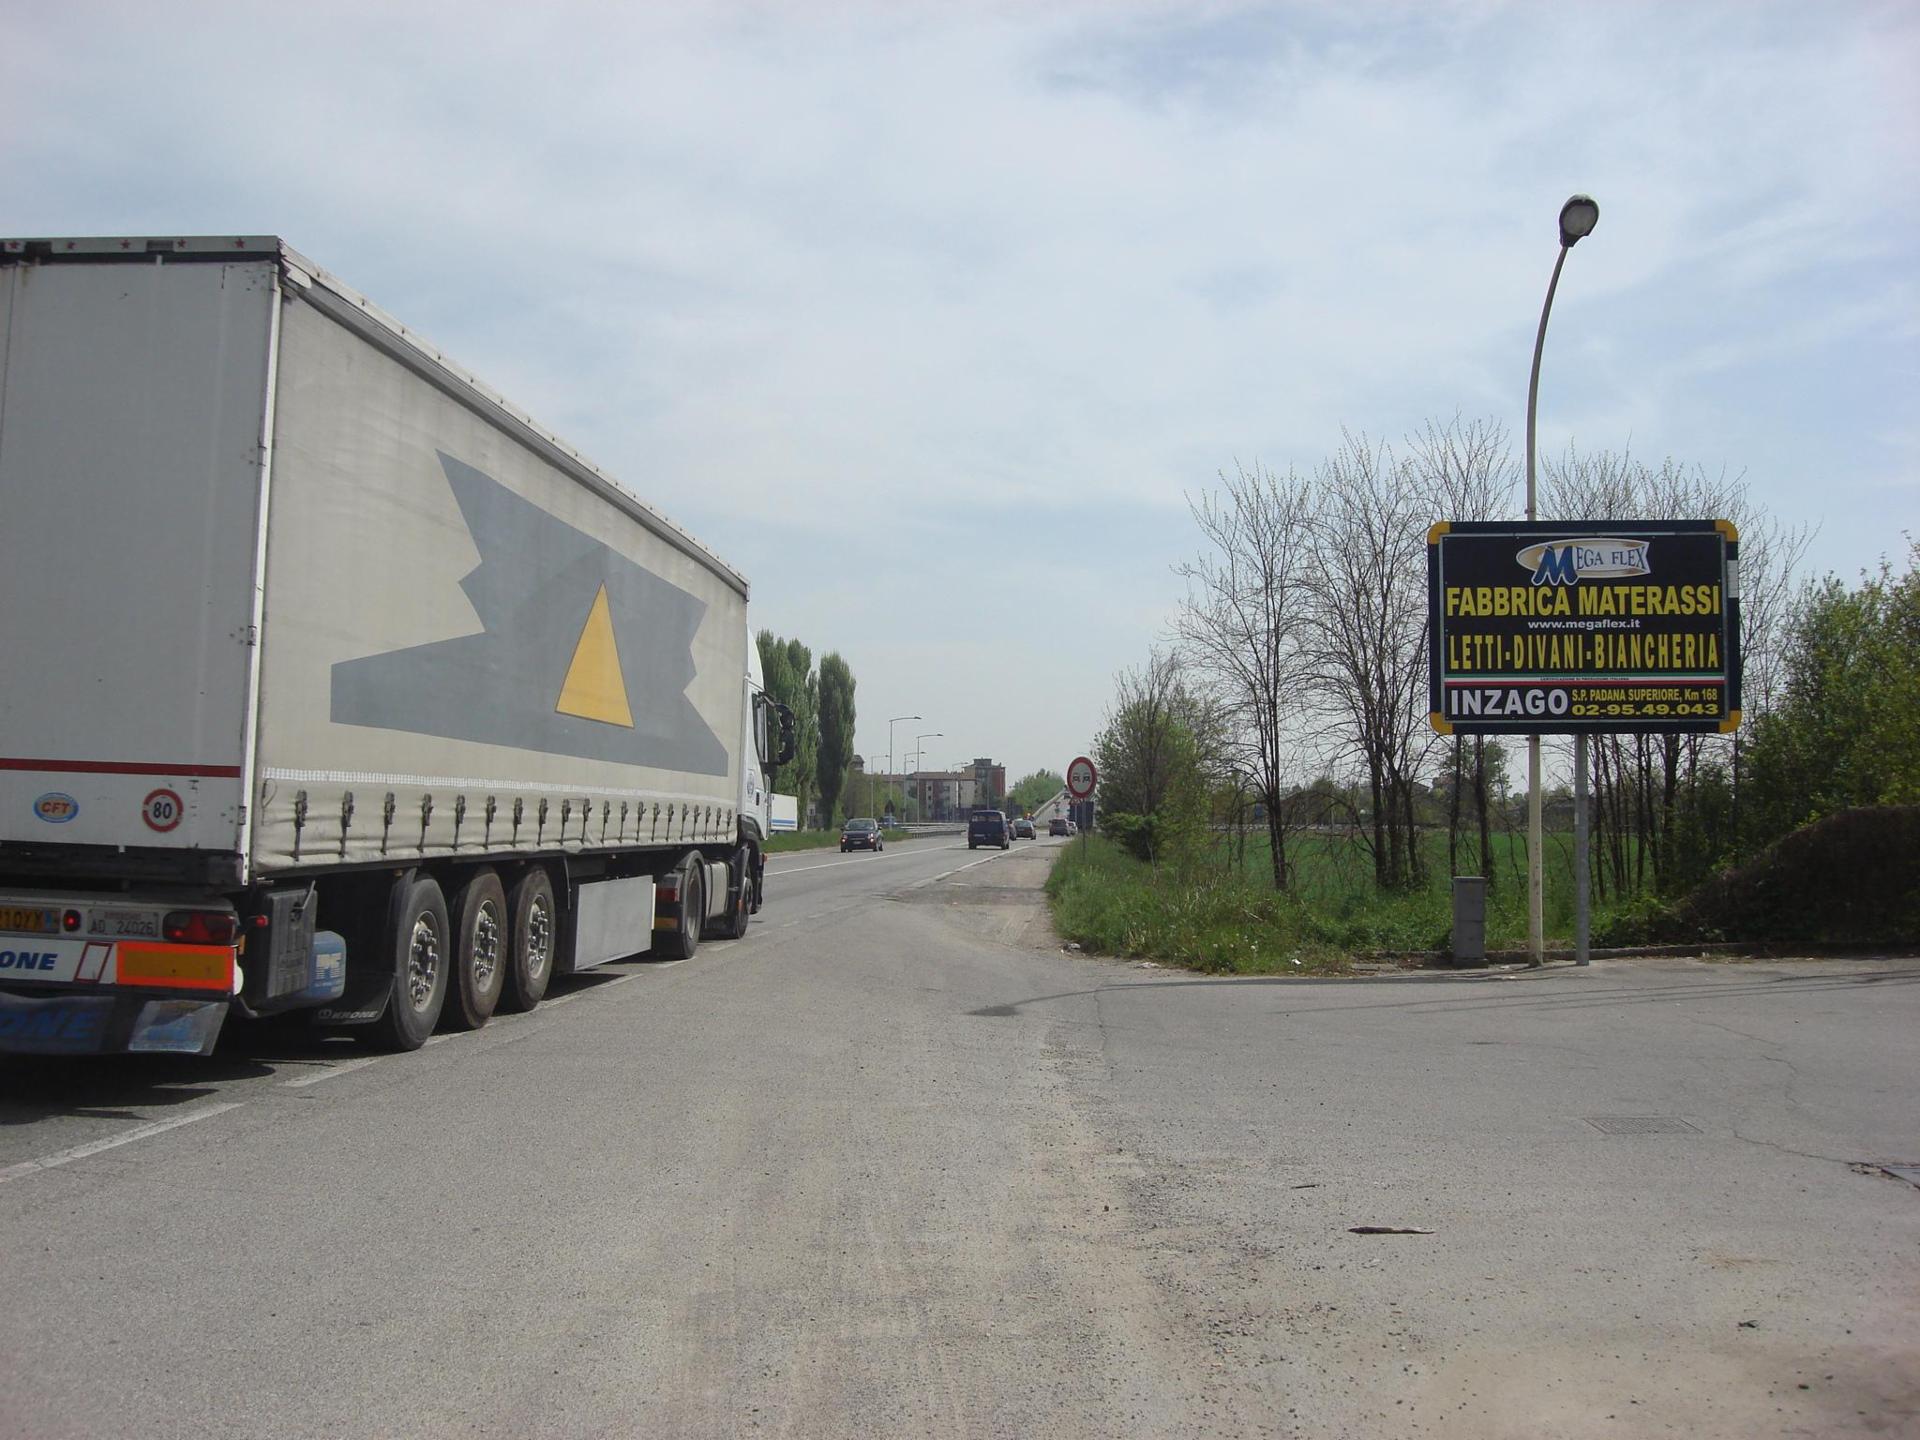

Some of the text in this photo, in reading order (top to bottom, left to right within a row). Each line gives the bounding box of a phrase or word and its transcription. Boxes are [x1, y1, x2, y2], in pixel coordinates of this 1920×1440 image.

[1531, 545, 1646, 585] MEGA FLEX
[1447, 585, 1720, 617] FABBRICA MATERASSI
[1528, 619, 1641, 631] www.megaflex.it
[1451, 688, 1718, 715] INZAGO S.P. PADANA SUPERIORE, Km 168
[1571, 703, 1720, 715] 02-95.49.043
[40, 801, 70, 815] CFT
[153, 801, 172, 819] 80
